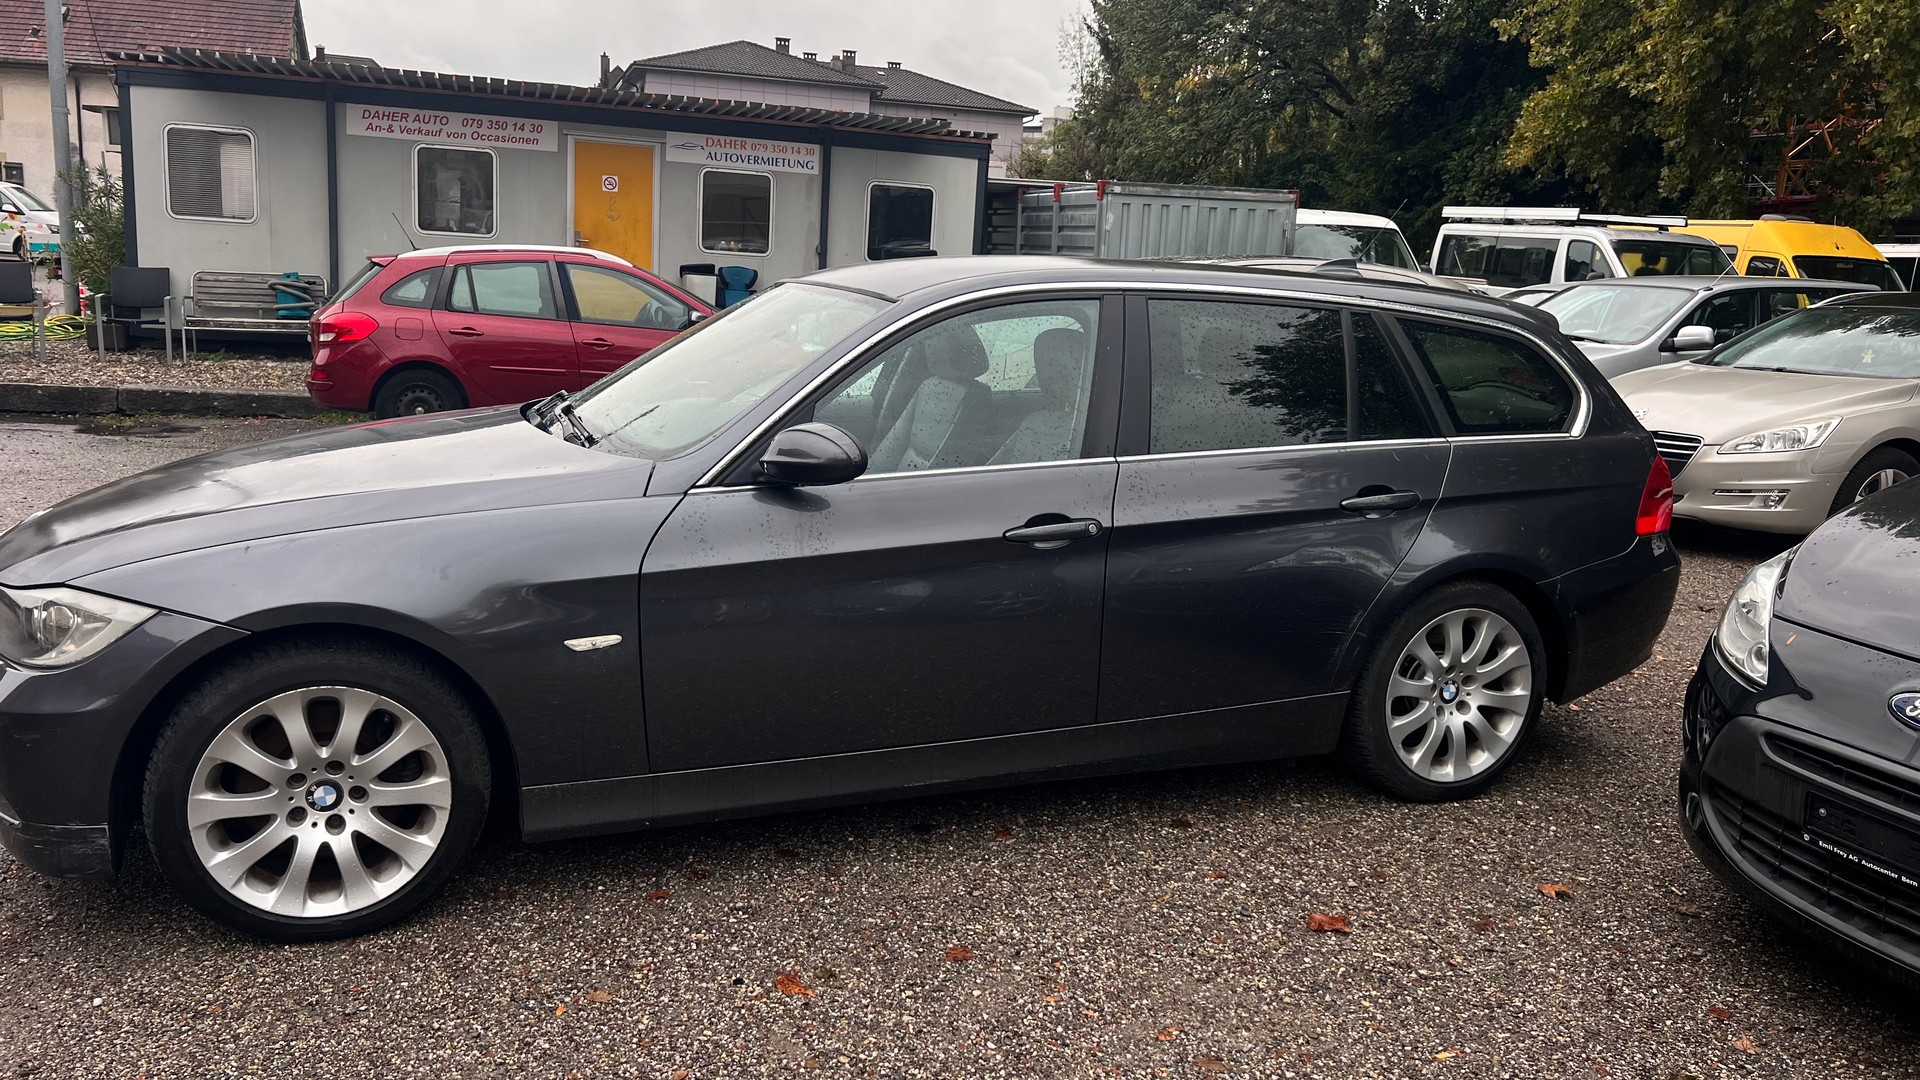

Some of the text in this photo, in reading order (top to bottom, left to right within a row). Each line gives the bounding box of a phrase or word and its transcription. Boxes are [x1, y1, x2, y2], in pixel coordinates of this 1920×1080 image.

[361, 109, 544, 134] DAHER AUTO 079 350 14 30
[365, 122, 539, 145] An-& Verkauf von Occasionen
[705, 137, 815, 157] DAHER 079 350 14 30
[706, 152, 815, 170] AUTOVERMIETUNG
[1818, 840, 1918, 887] Emil Frey AG Autocenter Bern
